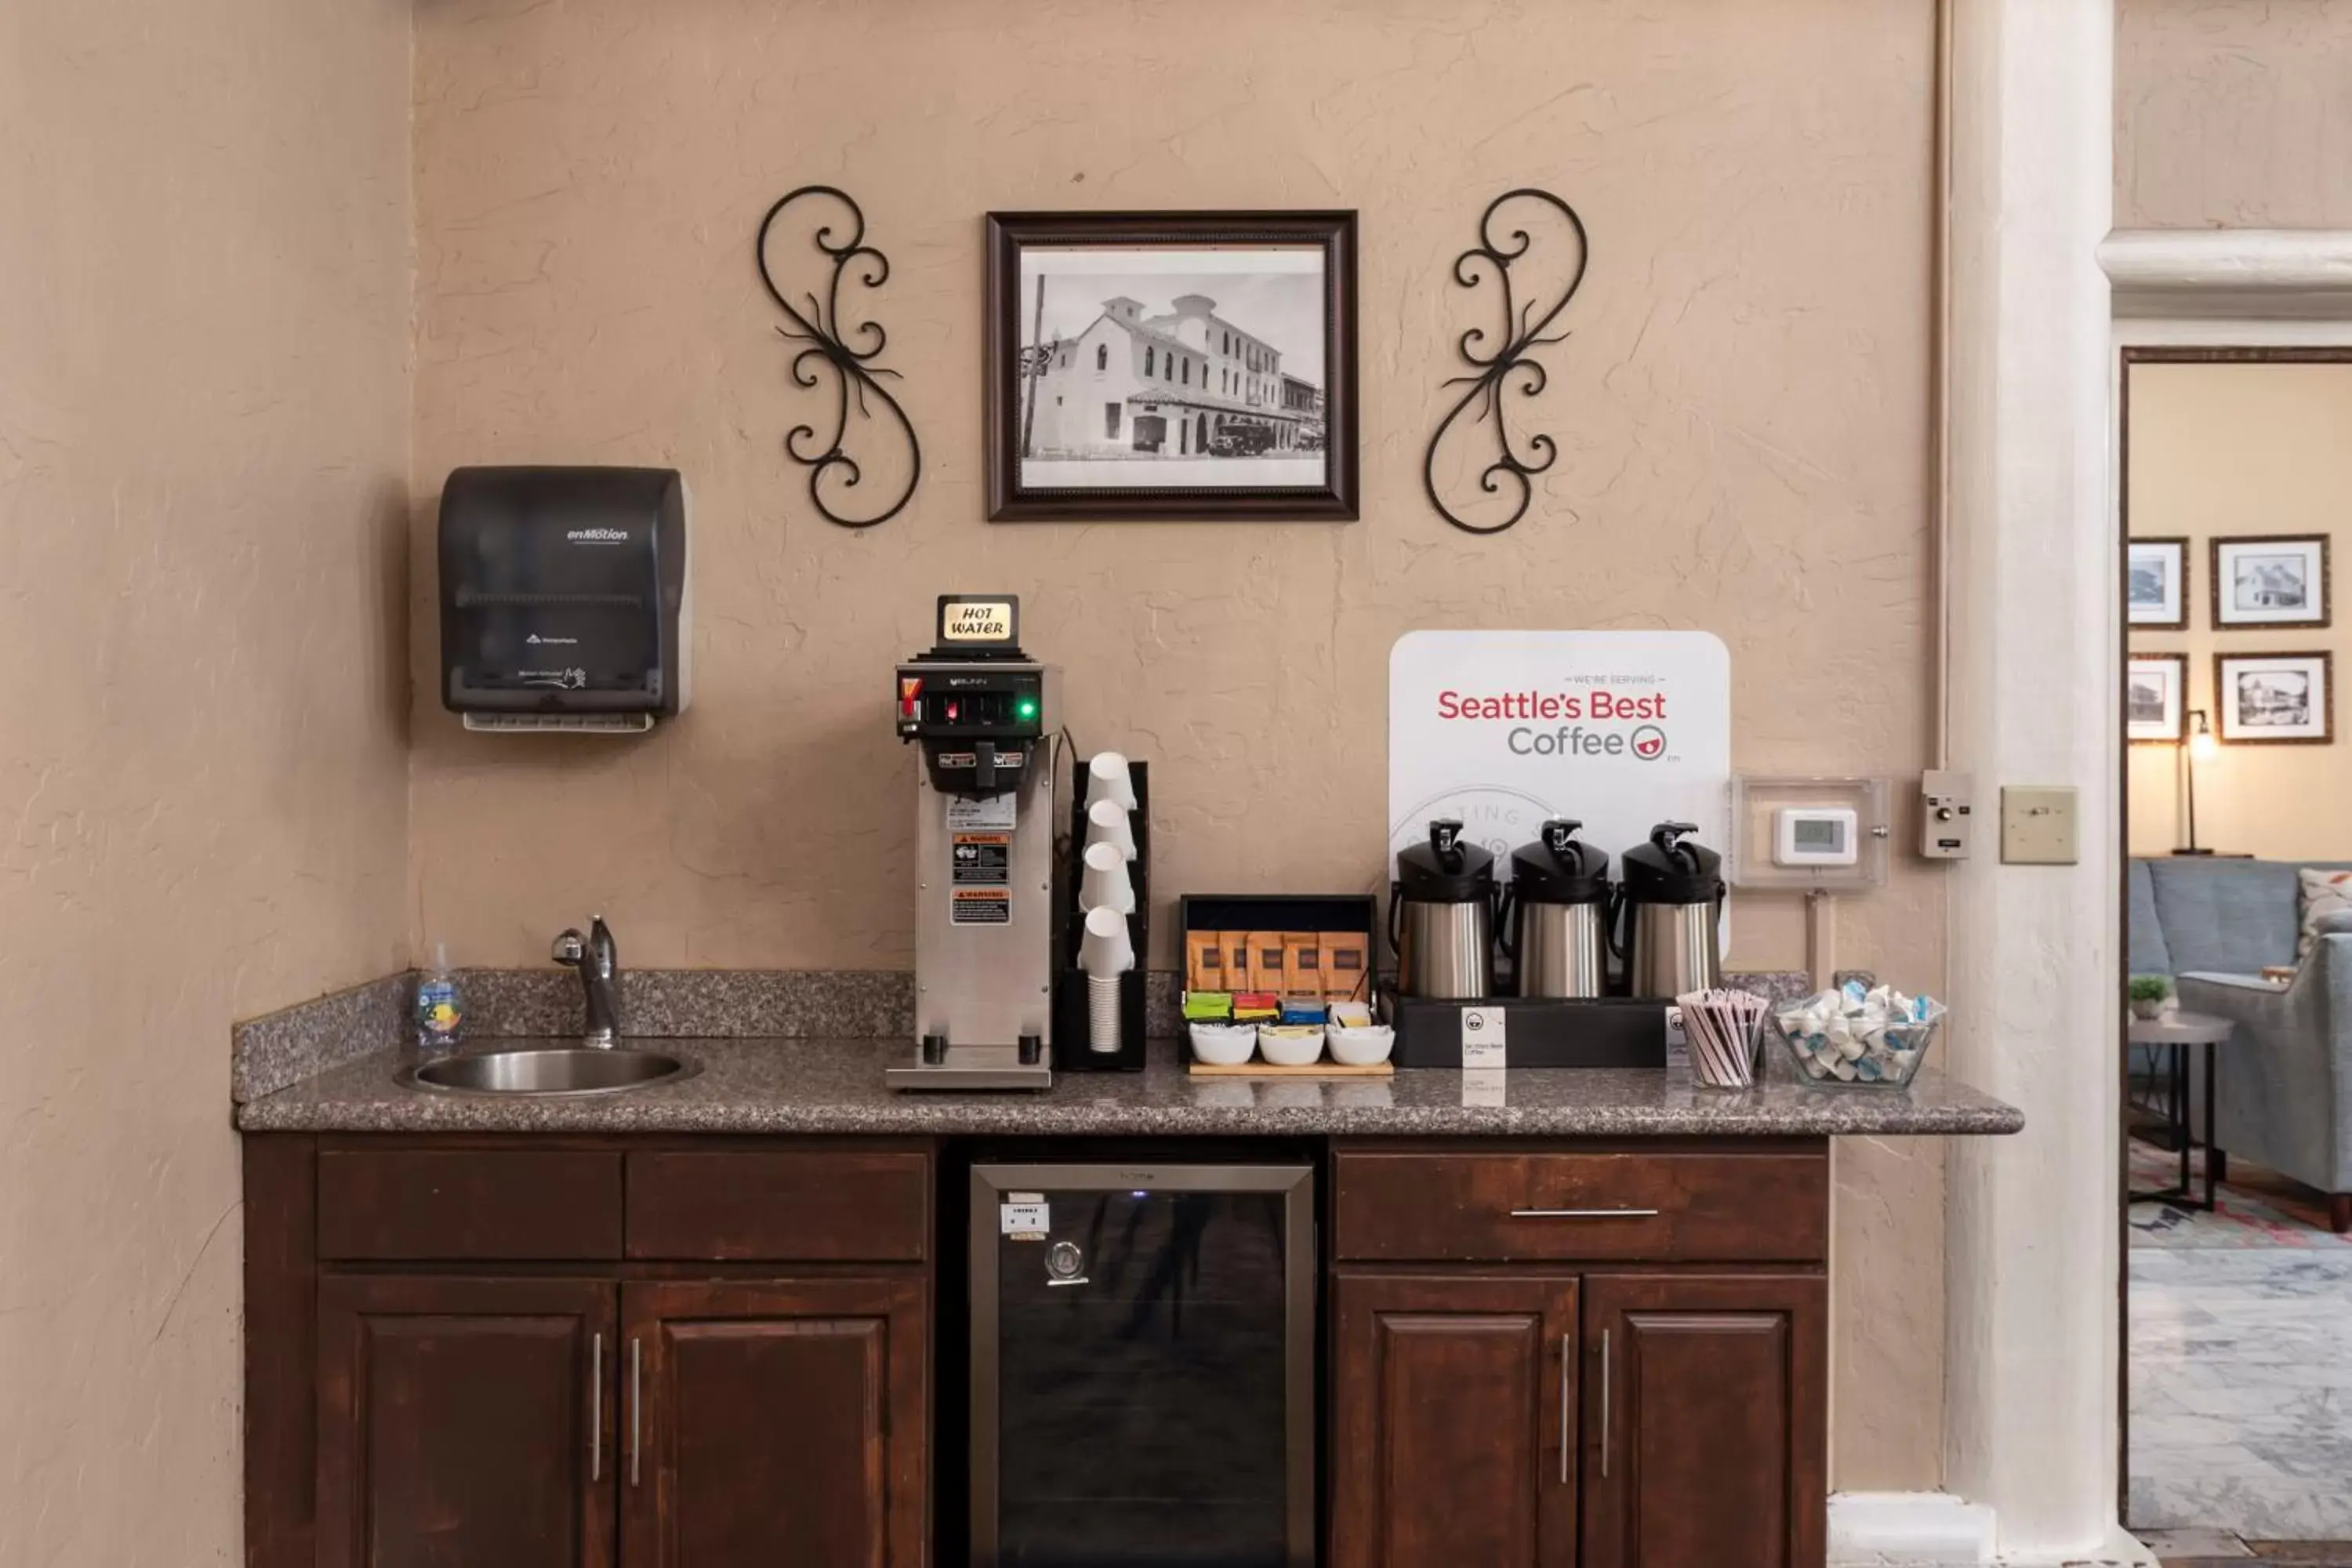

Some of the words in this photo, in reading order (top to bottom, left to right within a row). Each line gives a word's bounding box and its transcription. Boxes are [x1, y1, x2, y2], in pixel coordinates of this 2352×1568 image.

[567, 528, 628, 539] enMotion
[962, 608, 993, 619] HOT
[951, 622, 1004, 633] WATER
[1573, 675, 1607, 684] WE'RE
[1610, 675, 1655, 684] SERVING
[1438, 690, 1581, 720] Seattle's
[1590, 691, 1667, 720] Best
[1508, 726, 1624, 756] Coffee
